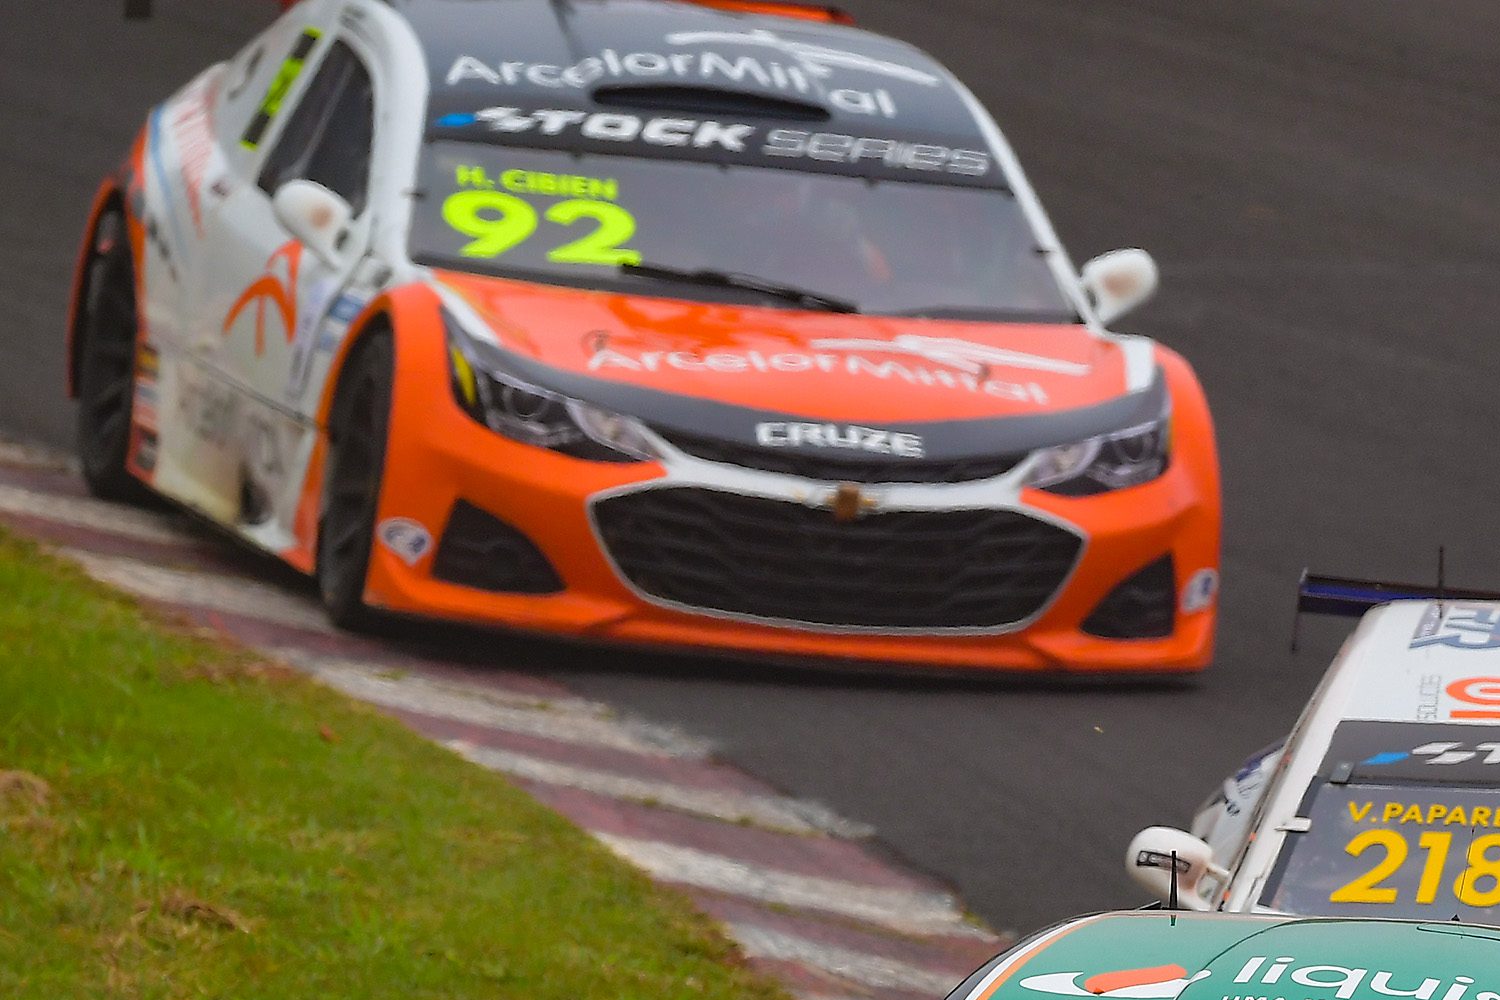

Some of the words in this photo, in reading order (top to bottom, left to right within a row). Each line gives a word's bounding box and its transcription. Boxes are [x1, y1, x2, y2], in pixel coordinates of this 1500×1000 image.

[475, 106, 753, 153] STOCK
[763, 128, 991, 177] SERIES
[501, 169, 619, 199] CIBIEN
[441, 190, 642, 267] 92
[755, 421, 924, 458] CRUZE
